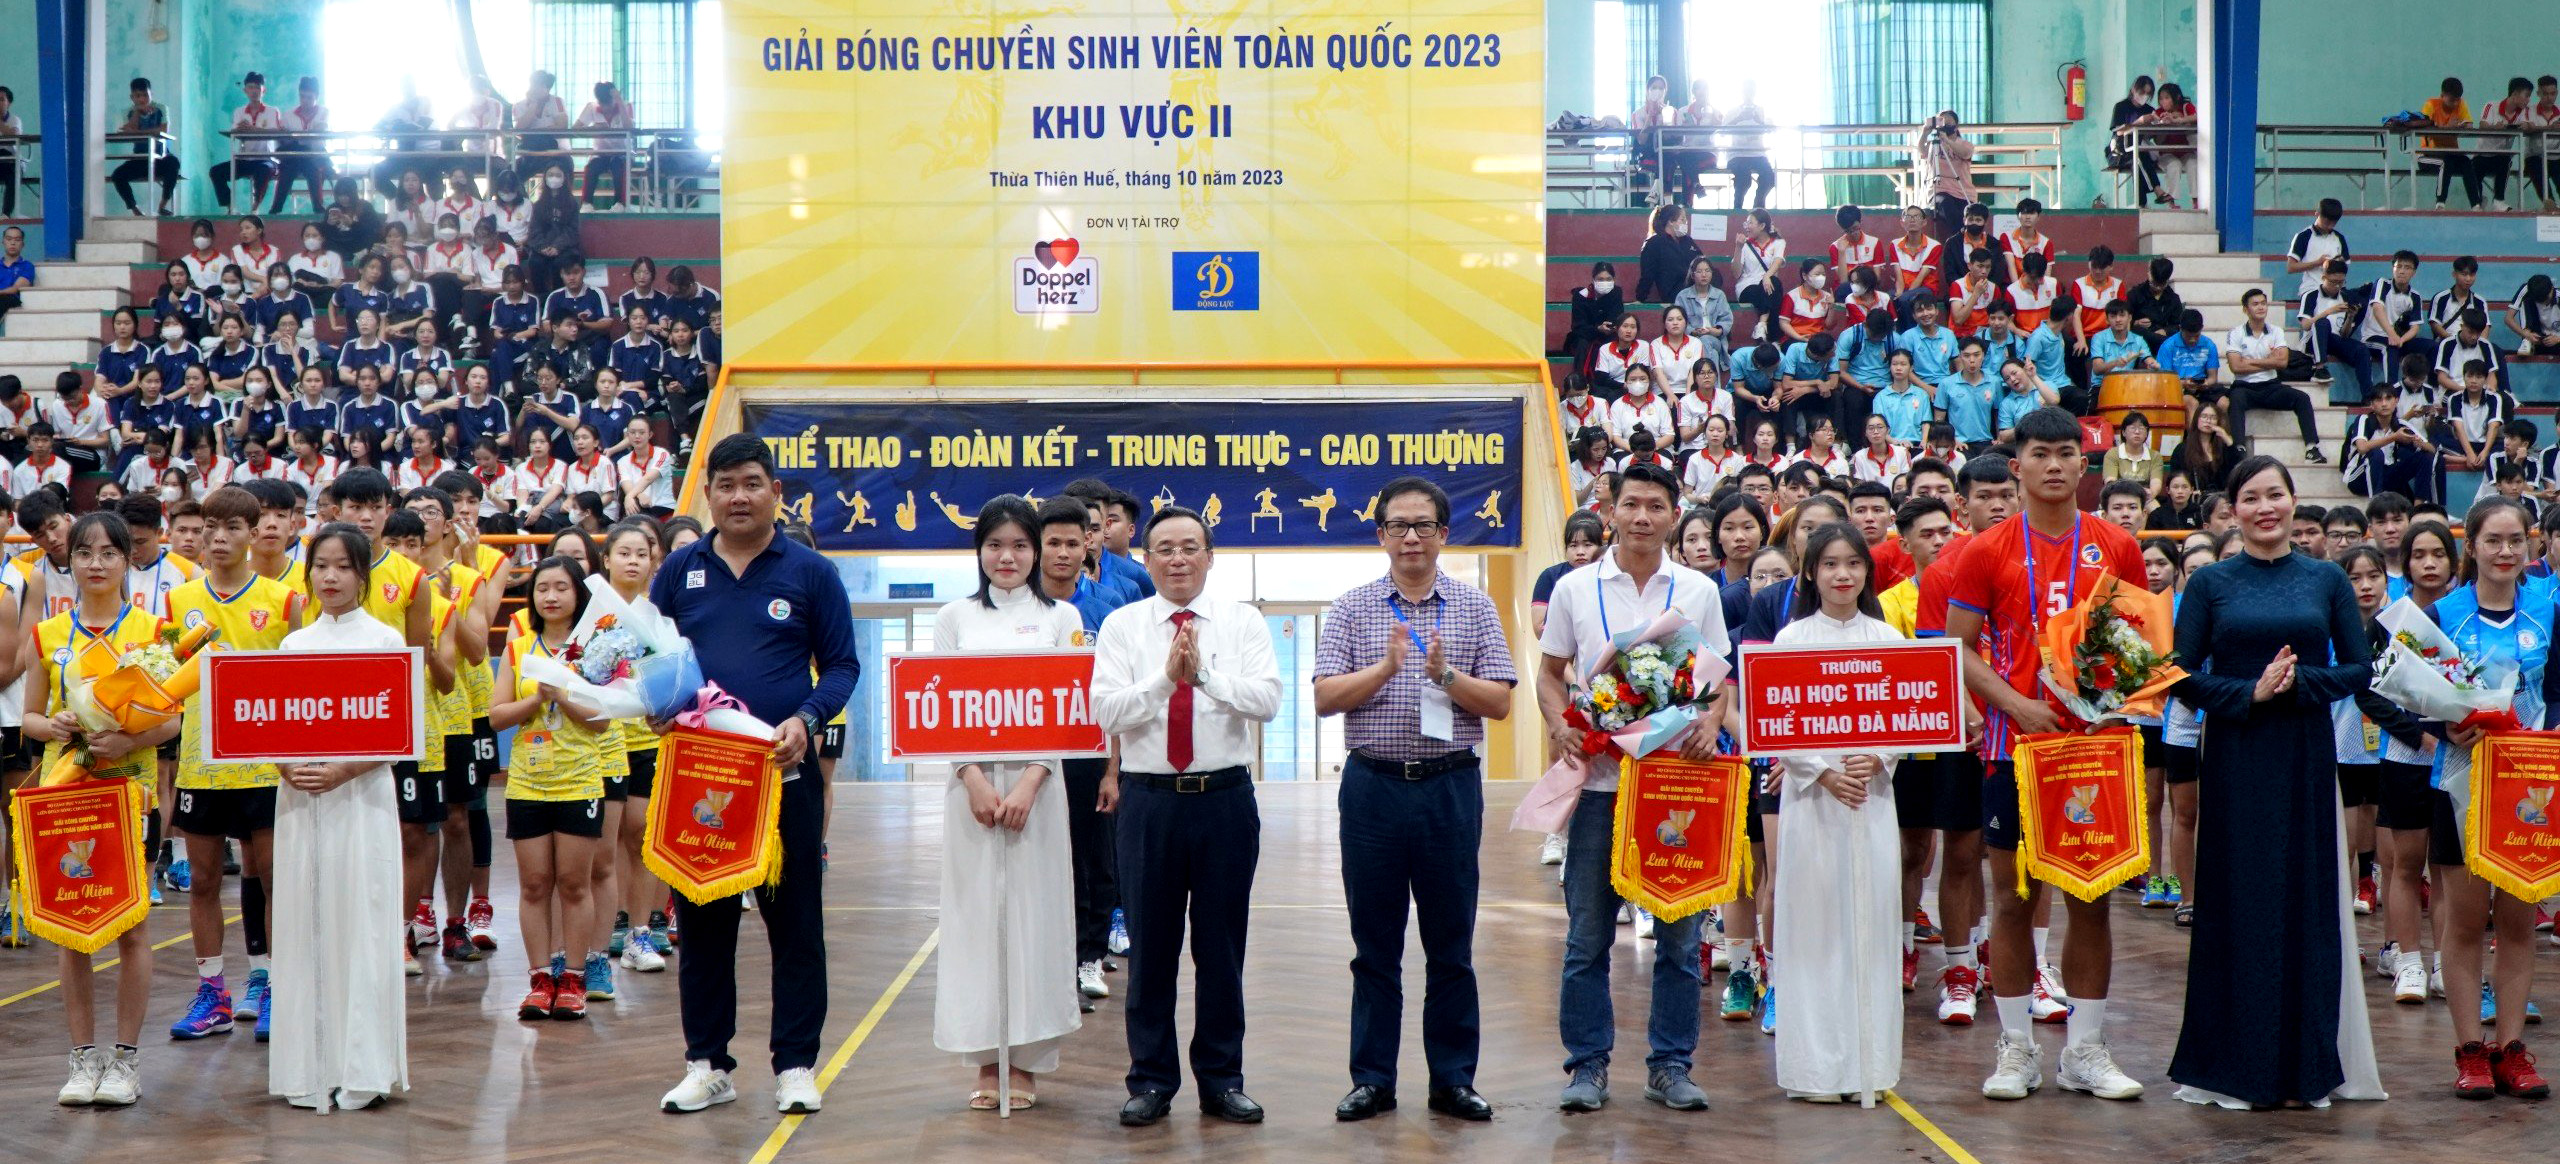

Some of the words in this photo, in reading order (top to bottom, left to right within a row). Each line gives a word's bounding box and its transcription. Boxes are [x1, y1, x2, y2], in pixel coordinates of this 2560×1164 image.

[763, 27, 823, 71] GIẢI
[837, 29, 920, 71] BÓNG
[932, 25, 1055, 70] CHUYỀN
[1068, 36, 1140, 70] SINH
[1151, 28, 1222, 69] VIÊN
[1233, 34, 1314, 68] TOÀN
[1327, 26, 1412, 71] QUỐC
[1424, 33, 1502, 67] 2023
[1033, 105, 1105, 139] KHU
[1119, 100, 1194, 146] VỰC
[1210, 104, 1232, 138] II
[989, 171, 1028, 187] Thừa
[1034, 171, 1078, 187] Thiên
[1084, 169, 1120, 188] Huế,
[1125, 170, 1171, 190] tháng
[1177, 170, 1197, 186] 10
[1203, 171, 1237, 186] năm
[1242, 170, 1284, 186] 2023
[1087, 216, 1114, 229] ĐƠN
[1116, 217, 1129, 230] VỊ
[1132, 215, 1150, 228] TÀI
[1153, 217, 1180, 229] TRỢ
[1023, 267, 1090, 290] Doppel
[1038, 287, 1078, 304] herz
[761, 425, 820, 468] THỂ
[825, 436, 901, 468] THAO
[929, 429, 1013, 467] ĐOÀN
[1022, 425, 1078, 467] KẾT
[1107, 435, 1206, 467] TRUNG
[1214, 430, 1290, 473] THỰC
[1320, 434, 1380, 465] CAO
[1387, 429, 1504, 472] THƯỢNG
[2047, 581, 2068, 617] 5
[1820, 658, 1883, 675] TRƯỜNG
[1766, 686, 1801, 708] ĐẠI
[1807, 684, 1848, 707] HỌC
[1854, 675, 1892, 702] THỂ
[1897, 681, 1938, 704] DỤC
[234, 698, 276, 727] ĐẠI
[284, 697, 333, 726] HỌC
[341, 688, 392, 720] HUẾ
[904, 674, 941, 730] TỔ
[948, 687, 1044, 737] TRỌNG
[1758, 710, 1796, 737] THỂ
[1801, 715, 1852, 735] THAO
[1858, 710, 1886, 733] ĐÀ
[1892, 706, 1949, 732] NẴNG
[825, 727, 839, 746] 11
[472, 738, 495, 760] 15
[468, 762, 476, 785] 6
[403, 778, 417, 802] 9
[676, 830, 700, 847] Lưu
[704, 833, 737, 852] Niệm
[2059, 832, 2081, 846] Lưu
[2083, 830, 2115, 847] Niệm
[2504, 830, 2528, 846] Lưu
[1645, 852, 1668, 867] Lưu
[1672, 853, 1704, 872] Niệm
[55, 886, 80, 902] Lưu
[82, 884, 114, 900] Niệm
